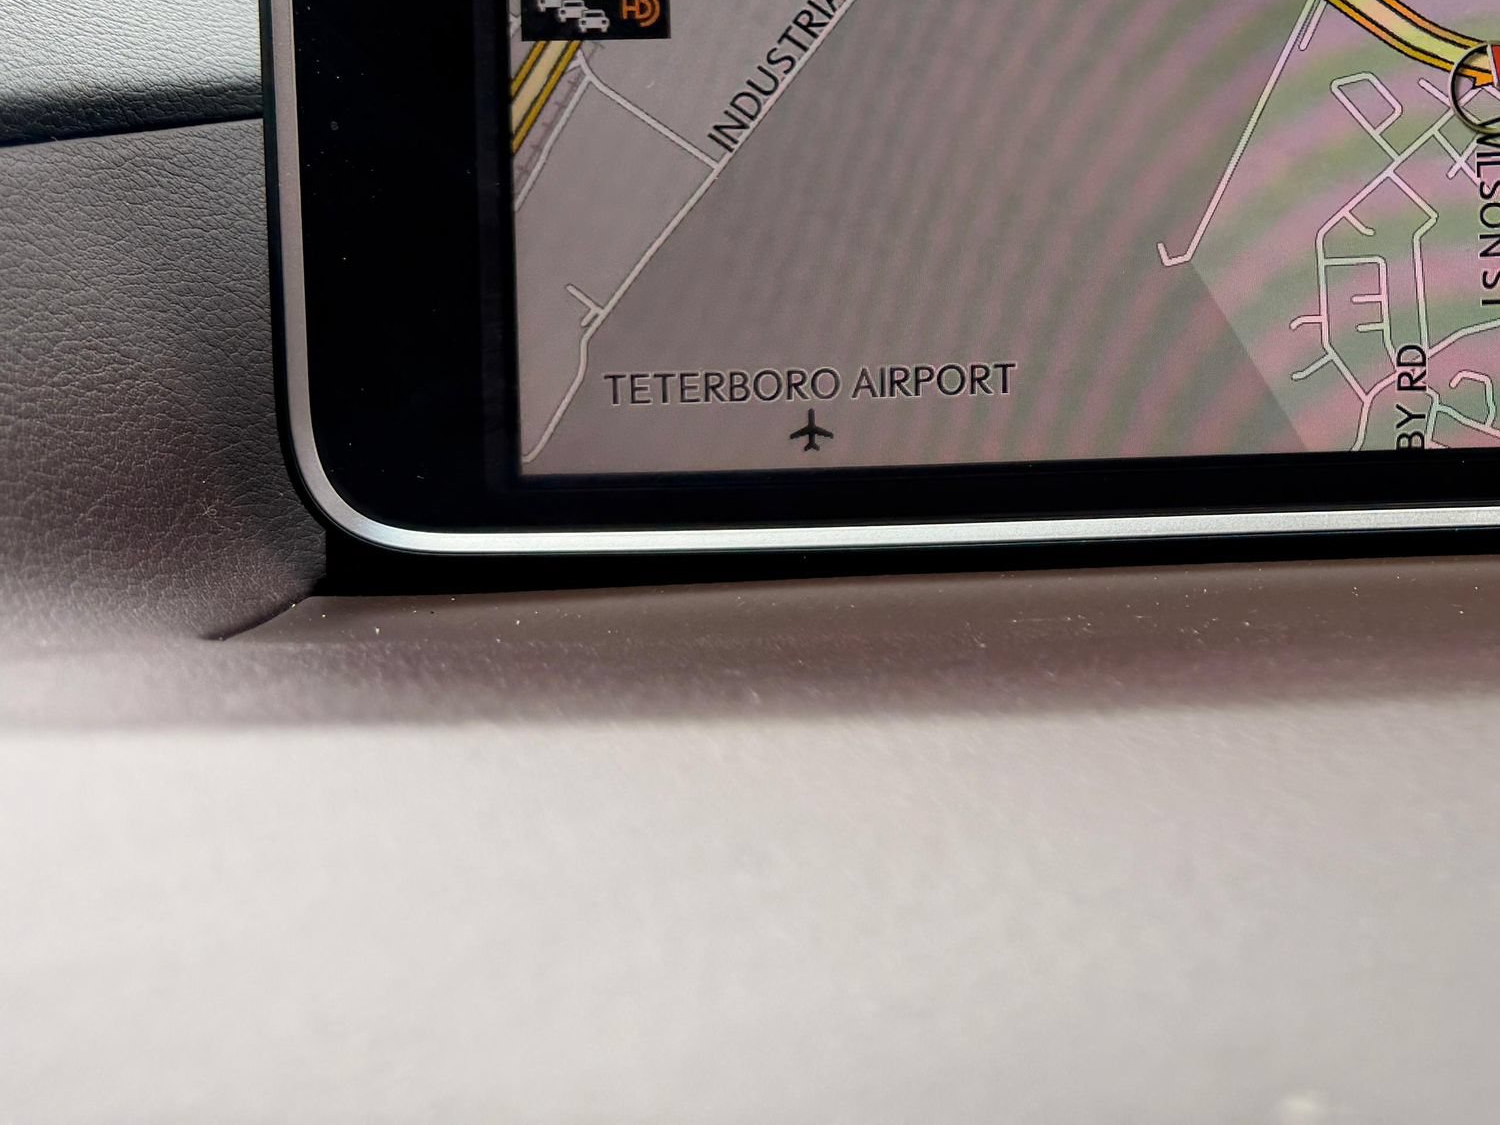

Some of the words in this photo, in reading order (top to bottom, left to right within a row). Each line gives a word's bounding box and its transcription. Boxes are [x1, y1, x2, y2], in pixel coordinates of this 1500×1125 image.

[603, 368, 841, 406] TETERBORO
[851, 362, 1017, 400] AIRPORT
[1396, 344, 1427, 391] RD
